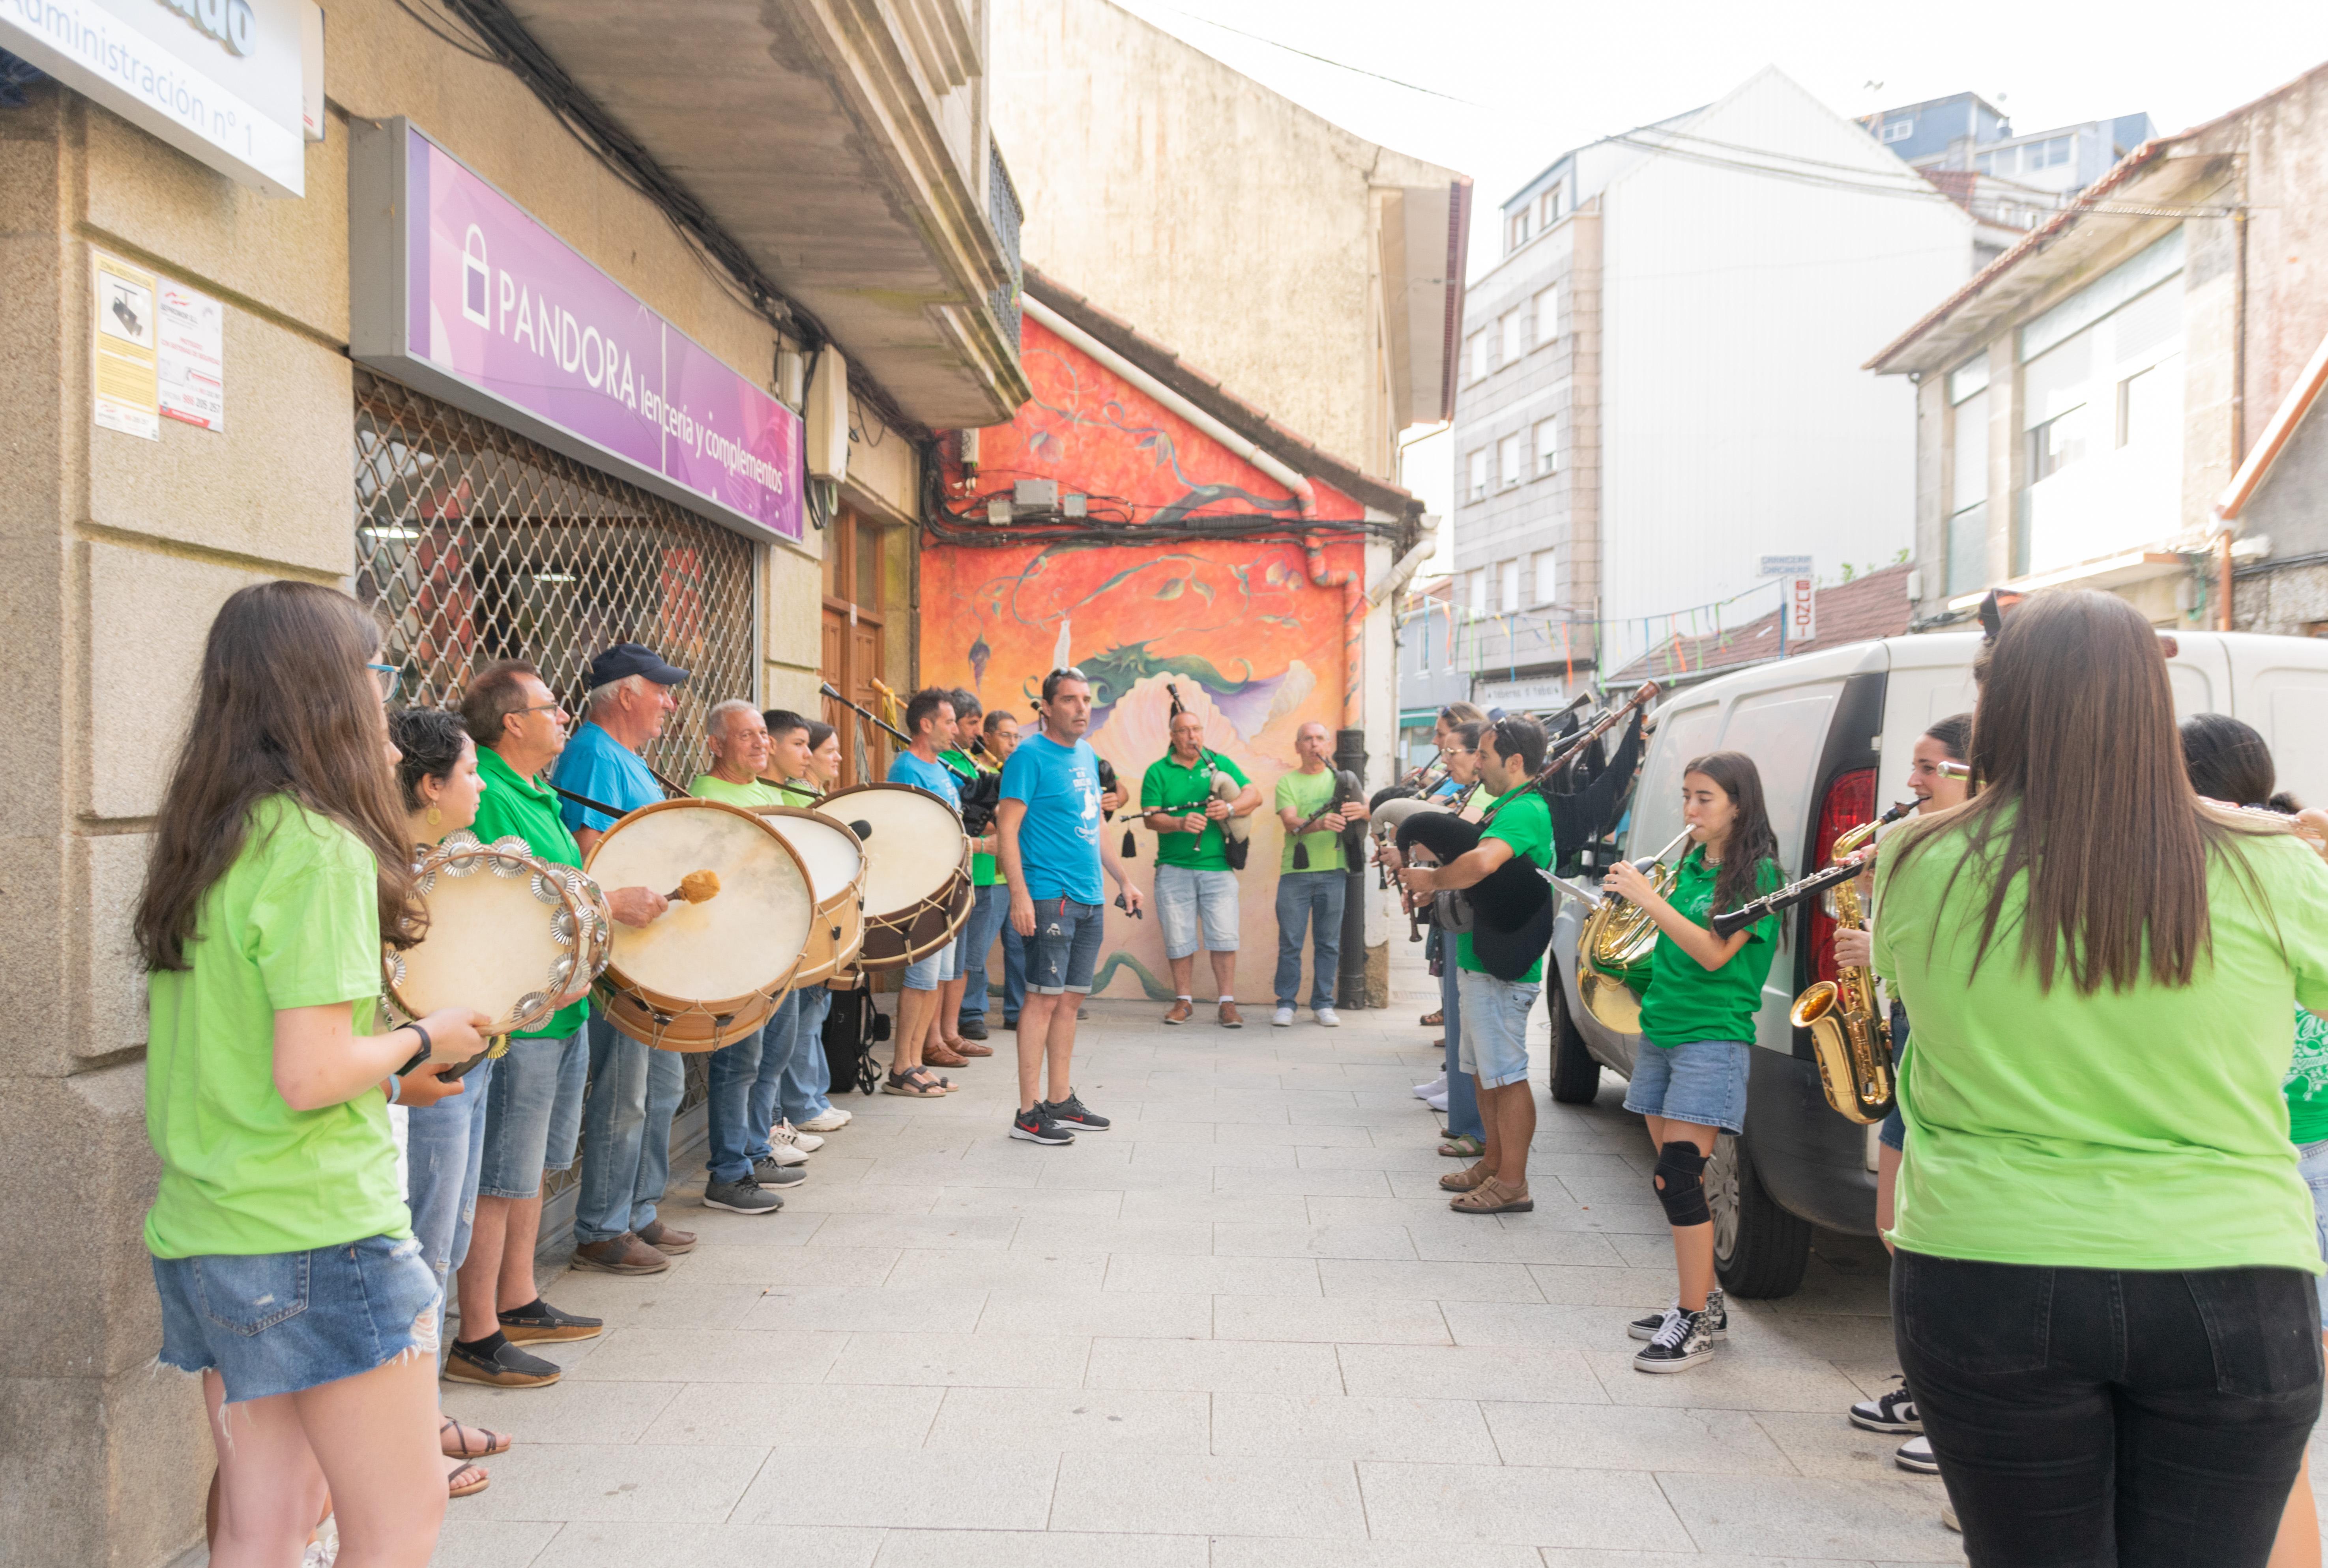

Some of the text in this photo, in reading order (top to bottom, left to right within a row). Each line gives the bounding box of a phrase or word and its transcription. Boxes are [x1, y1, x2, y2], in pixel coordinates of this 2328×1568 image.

[245, 123, 253, 156] 1
[499, 268, 783, 495] PANDORA lencería y complementos
